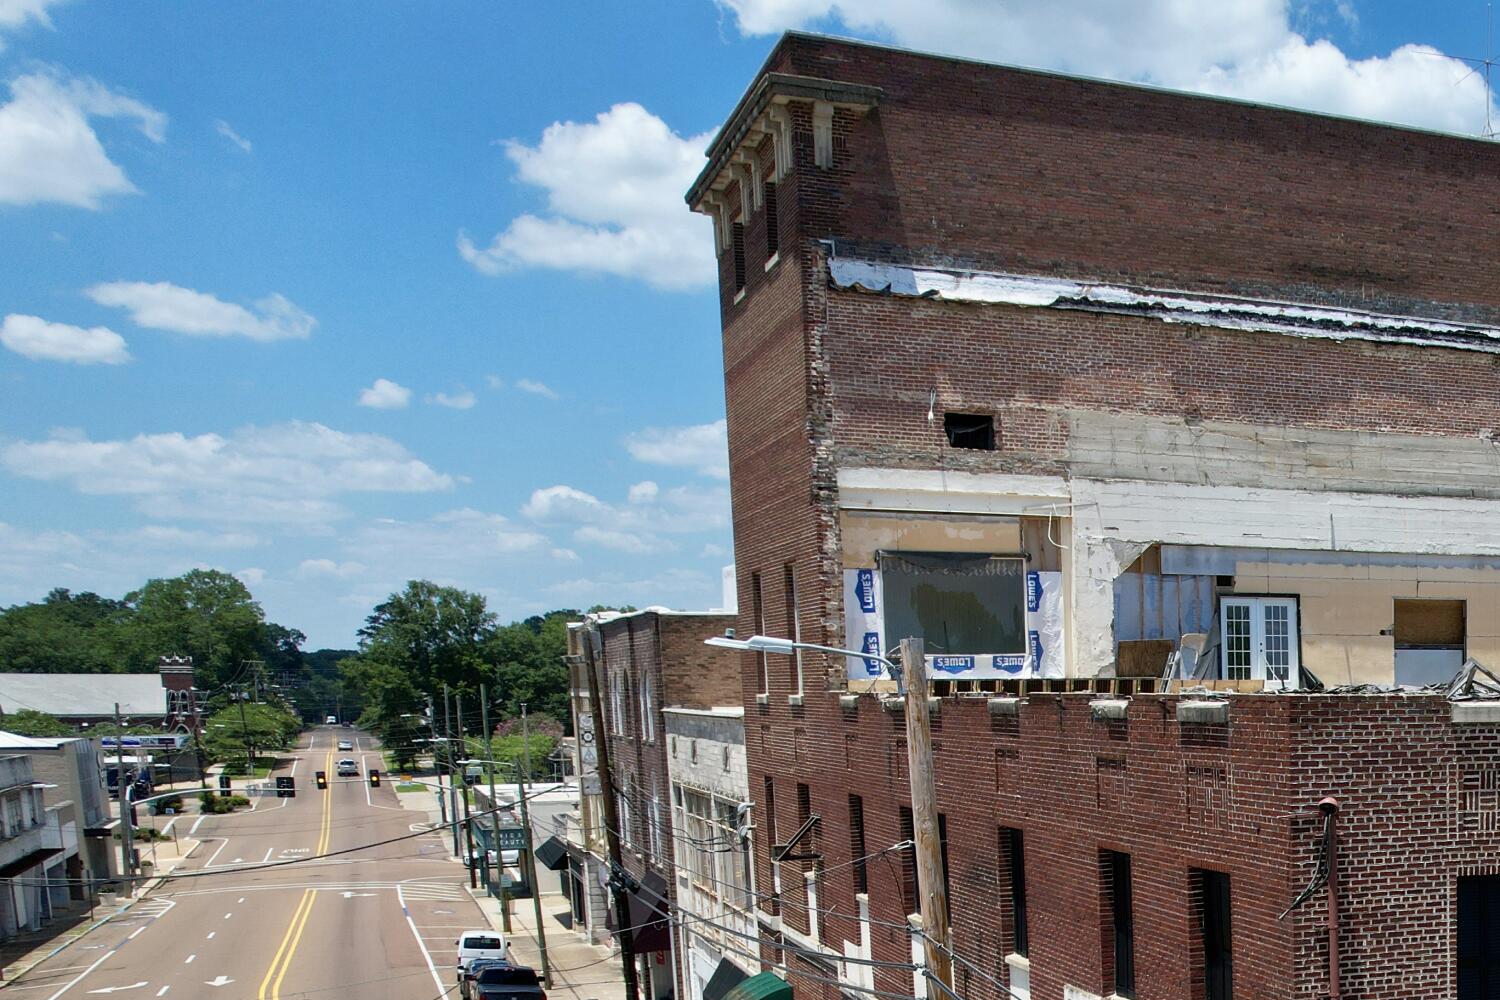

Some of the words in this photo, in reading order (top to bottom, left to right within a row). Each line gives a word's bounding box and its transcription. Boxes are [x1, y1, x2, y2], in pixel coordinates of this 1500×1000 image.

[862, 573, 875, 609] LOWE'S
[1027, 573, 1037, 609] LOWE'S
[937, 656, 971, 667] LOWE'S
[996, 656, 1024, 667] OWE'S
